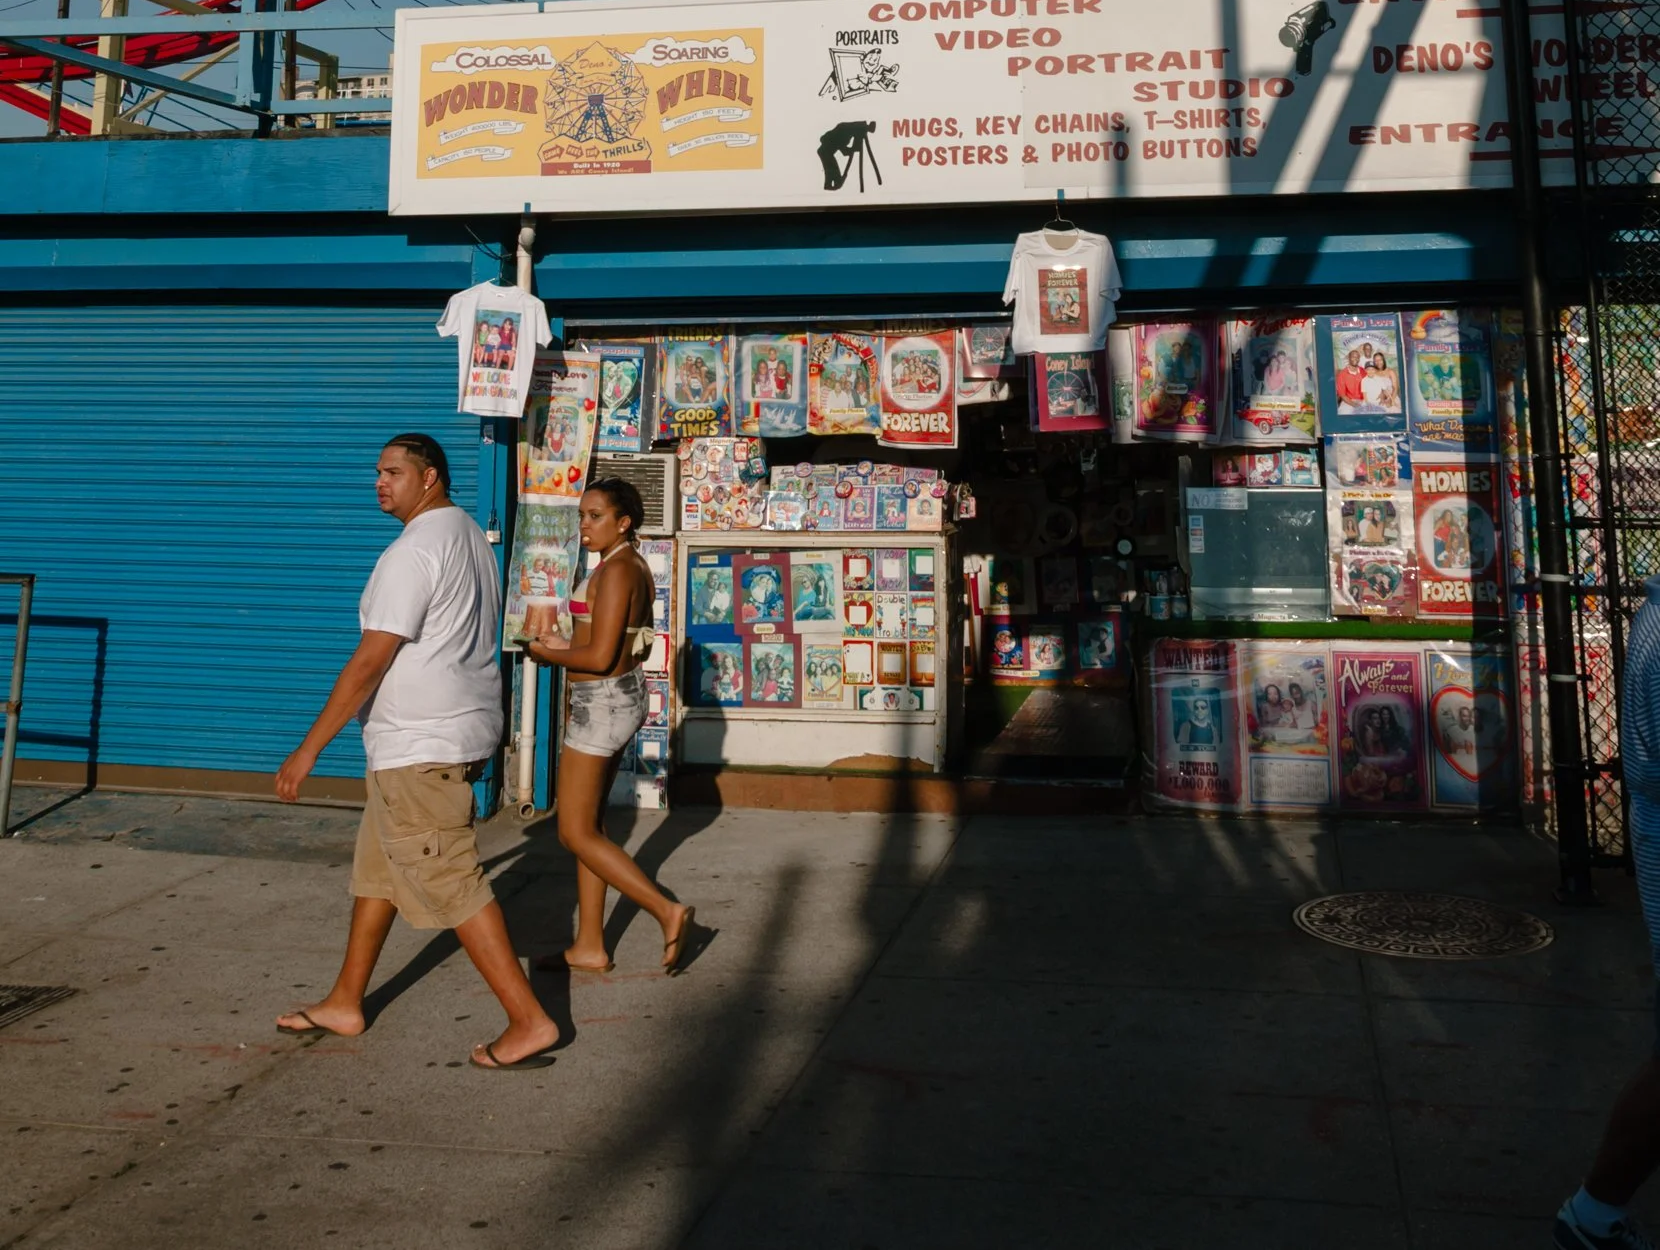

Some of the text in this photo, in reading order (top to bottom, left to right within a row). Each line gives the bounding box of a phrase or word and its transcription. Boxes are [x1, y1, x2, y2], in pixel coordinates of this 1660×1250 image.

[835, 28, 899, 46] PORTRAITS
[934, 27, 1062, 51] VIDEO
[652, 44, 729, 62] SOARING
[1373, 41, 1494, 74] DENO'S
[1530, 33, 1660, 69] ODER
[456, 52, 551, 69] COLOSSAL
[1007, 47, 1230, 77] PORTRAIT
[657, 68, 753, 115] WHEEL
[1132, 77, 1295, 103] STUDIO
[424, 81, 538, 128] WONDER
[892, 107, 1267, 139] MUGS, KEY CHAINS, T-SHIRTS,
[602, 137, 648, 159] THRILLS!
[902, 138, 1258, 166] POSTERS & PHOTO BUTTONS
[1048, 271, 1077, 279] HOMIES
[1048, 279, 1078, 287] FOREVER
[472, 371, 510, 385] WE LOVE
[674, 407, 717, 422] GOOD
[882, 411, 950, 433] FOREVER
[670, 420, 720, 437] TIMES
[1421, 470, 1491, 493] HOMIES
[1192, 493, 1210, 507] NO
[532, 514, 558, 524] OUR
[877, 595, 905, 603] Double
[1421, 580, 1498, 603] FOREVER
[878, 626, 907, 639] Troble
[1338, 656, 1395, 707] Always
[1391, 671, 1410, 681] and
[1367, 681, 1414, 694] Forever
[1179, 760, 1218, 776] REWARD
